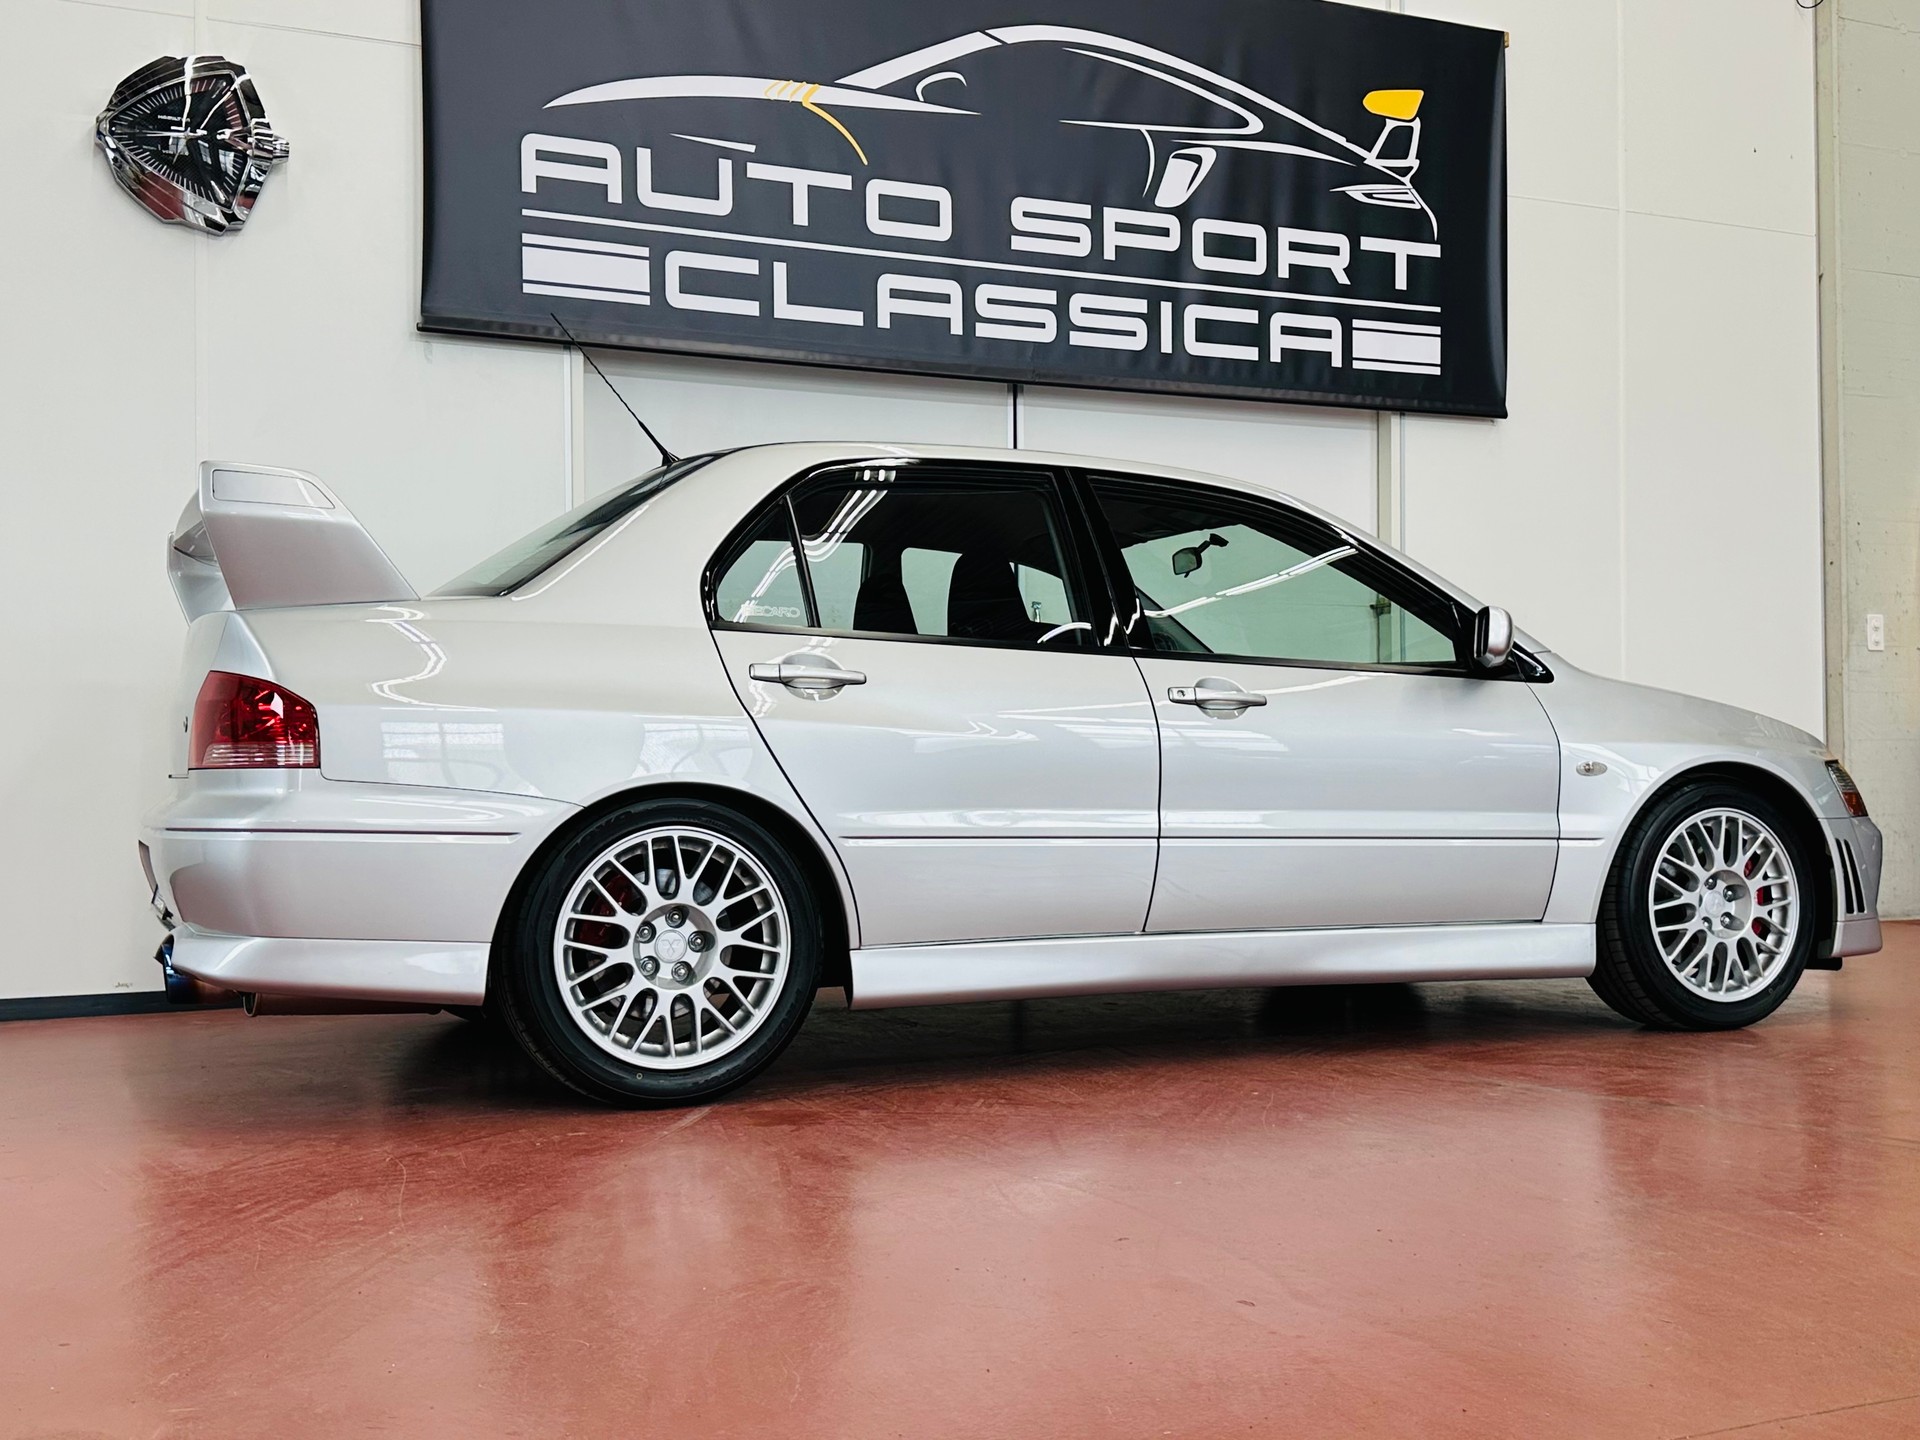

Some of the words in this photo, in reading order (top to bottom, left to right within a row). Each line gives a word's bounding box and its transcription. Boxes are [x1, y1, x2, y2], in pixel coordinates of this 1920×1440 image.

[520, 133, 953, 242] AUTO
[1010, 196, 1441, 291] SPORT
[664, 250, 1343, 368] CLASSICA
